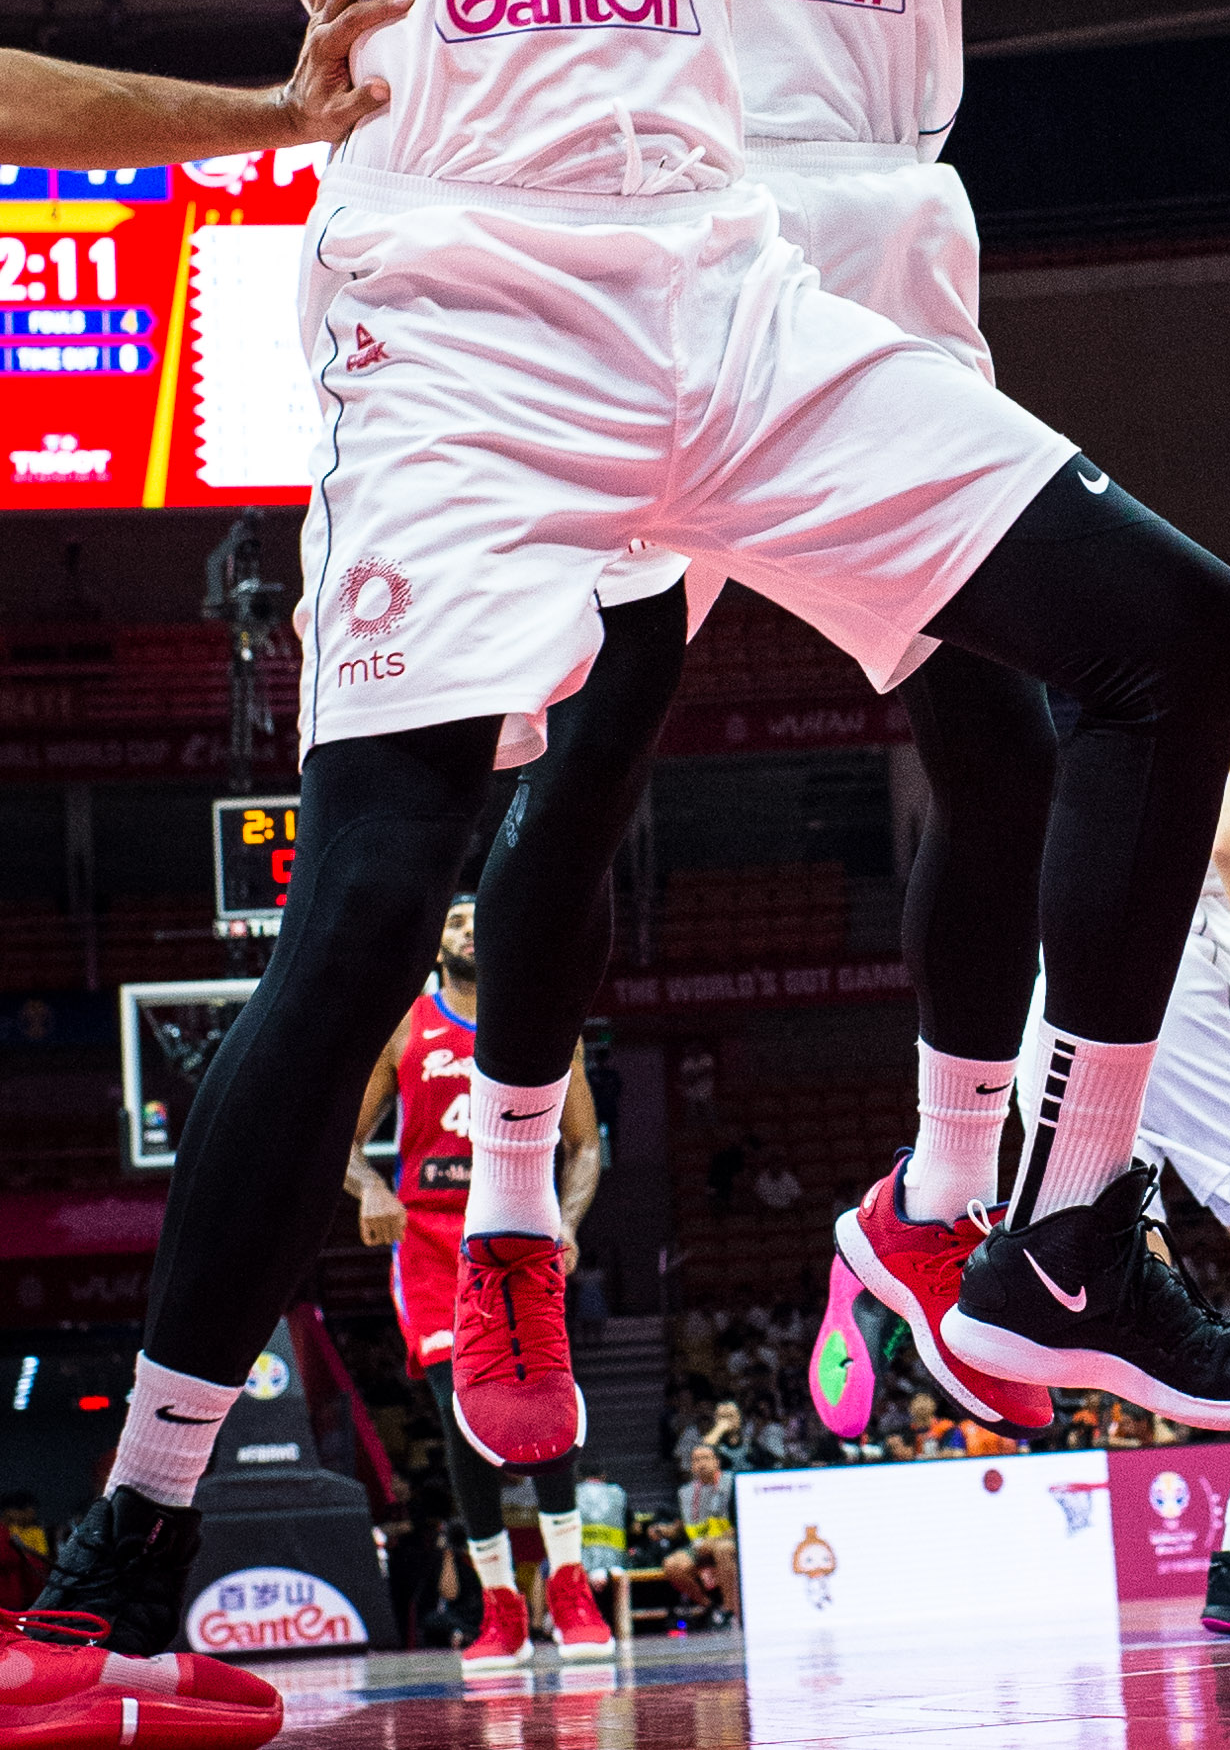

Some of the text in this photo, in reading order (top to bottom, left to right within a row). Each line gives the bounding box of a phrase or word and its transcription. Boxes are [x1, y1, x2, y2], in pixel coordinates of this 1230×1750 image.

[0, 237, 117, 302] 2:11
[338, 651, 407, 688] mts
[199, 1604, 350, 1648] Ganten
